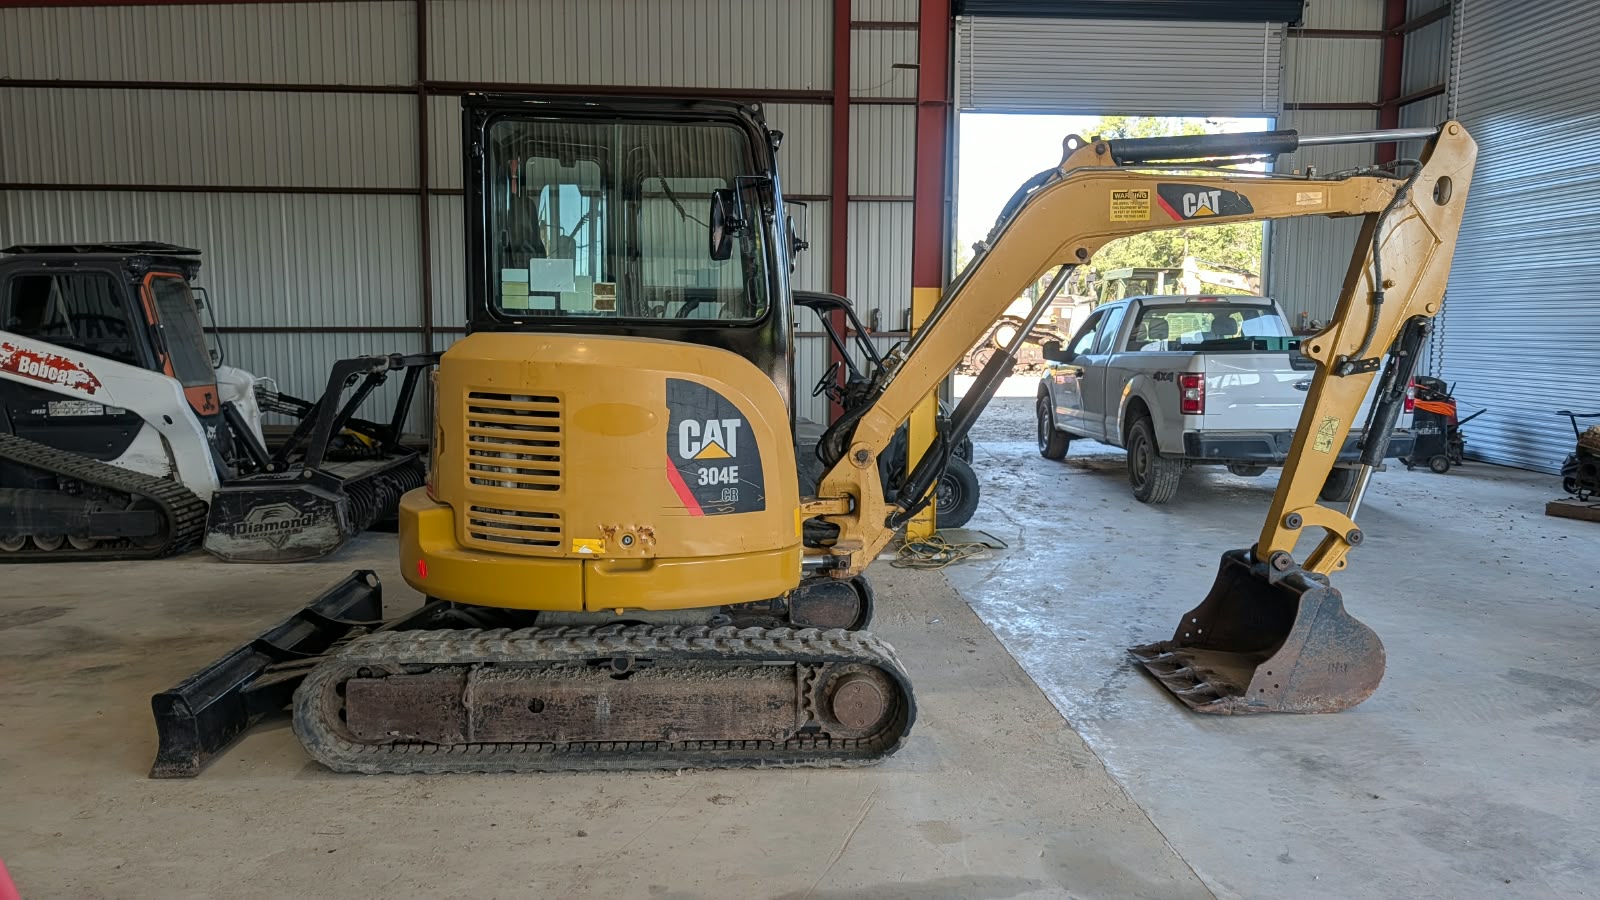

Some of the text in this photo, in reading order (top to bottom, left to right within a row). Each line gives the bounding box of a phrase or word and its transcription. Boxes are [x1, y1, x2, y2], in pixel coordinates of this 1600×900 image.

[1183, 190, 1221, 217] CAT
[678, 418, 741, 459] CAT
[697, 465, 739, 486] 304E
[721, 487, 739, 502] CR
[236, 514, 312, 534] Diamond
